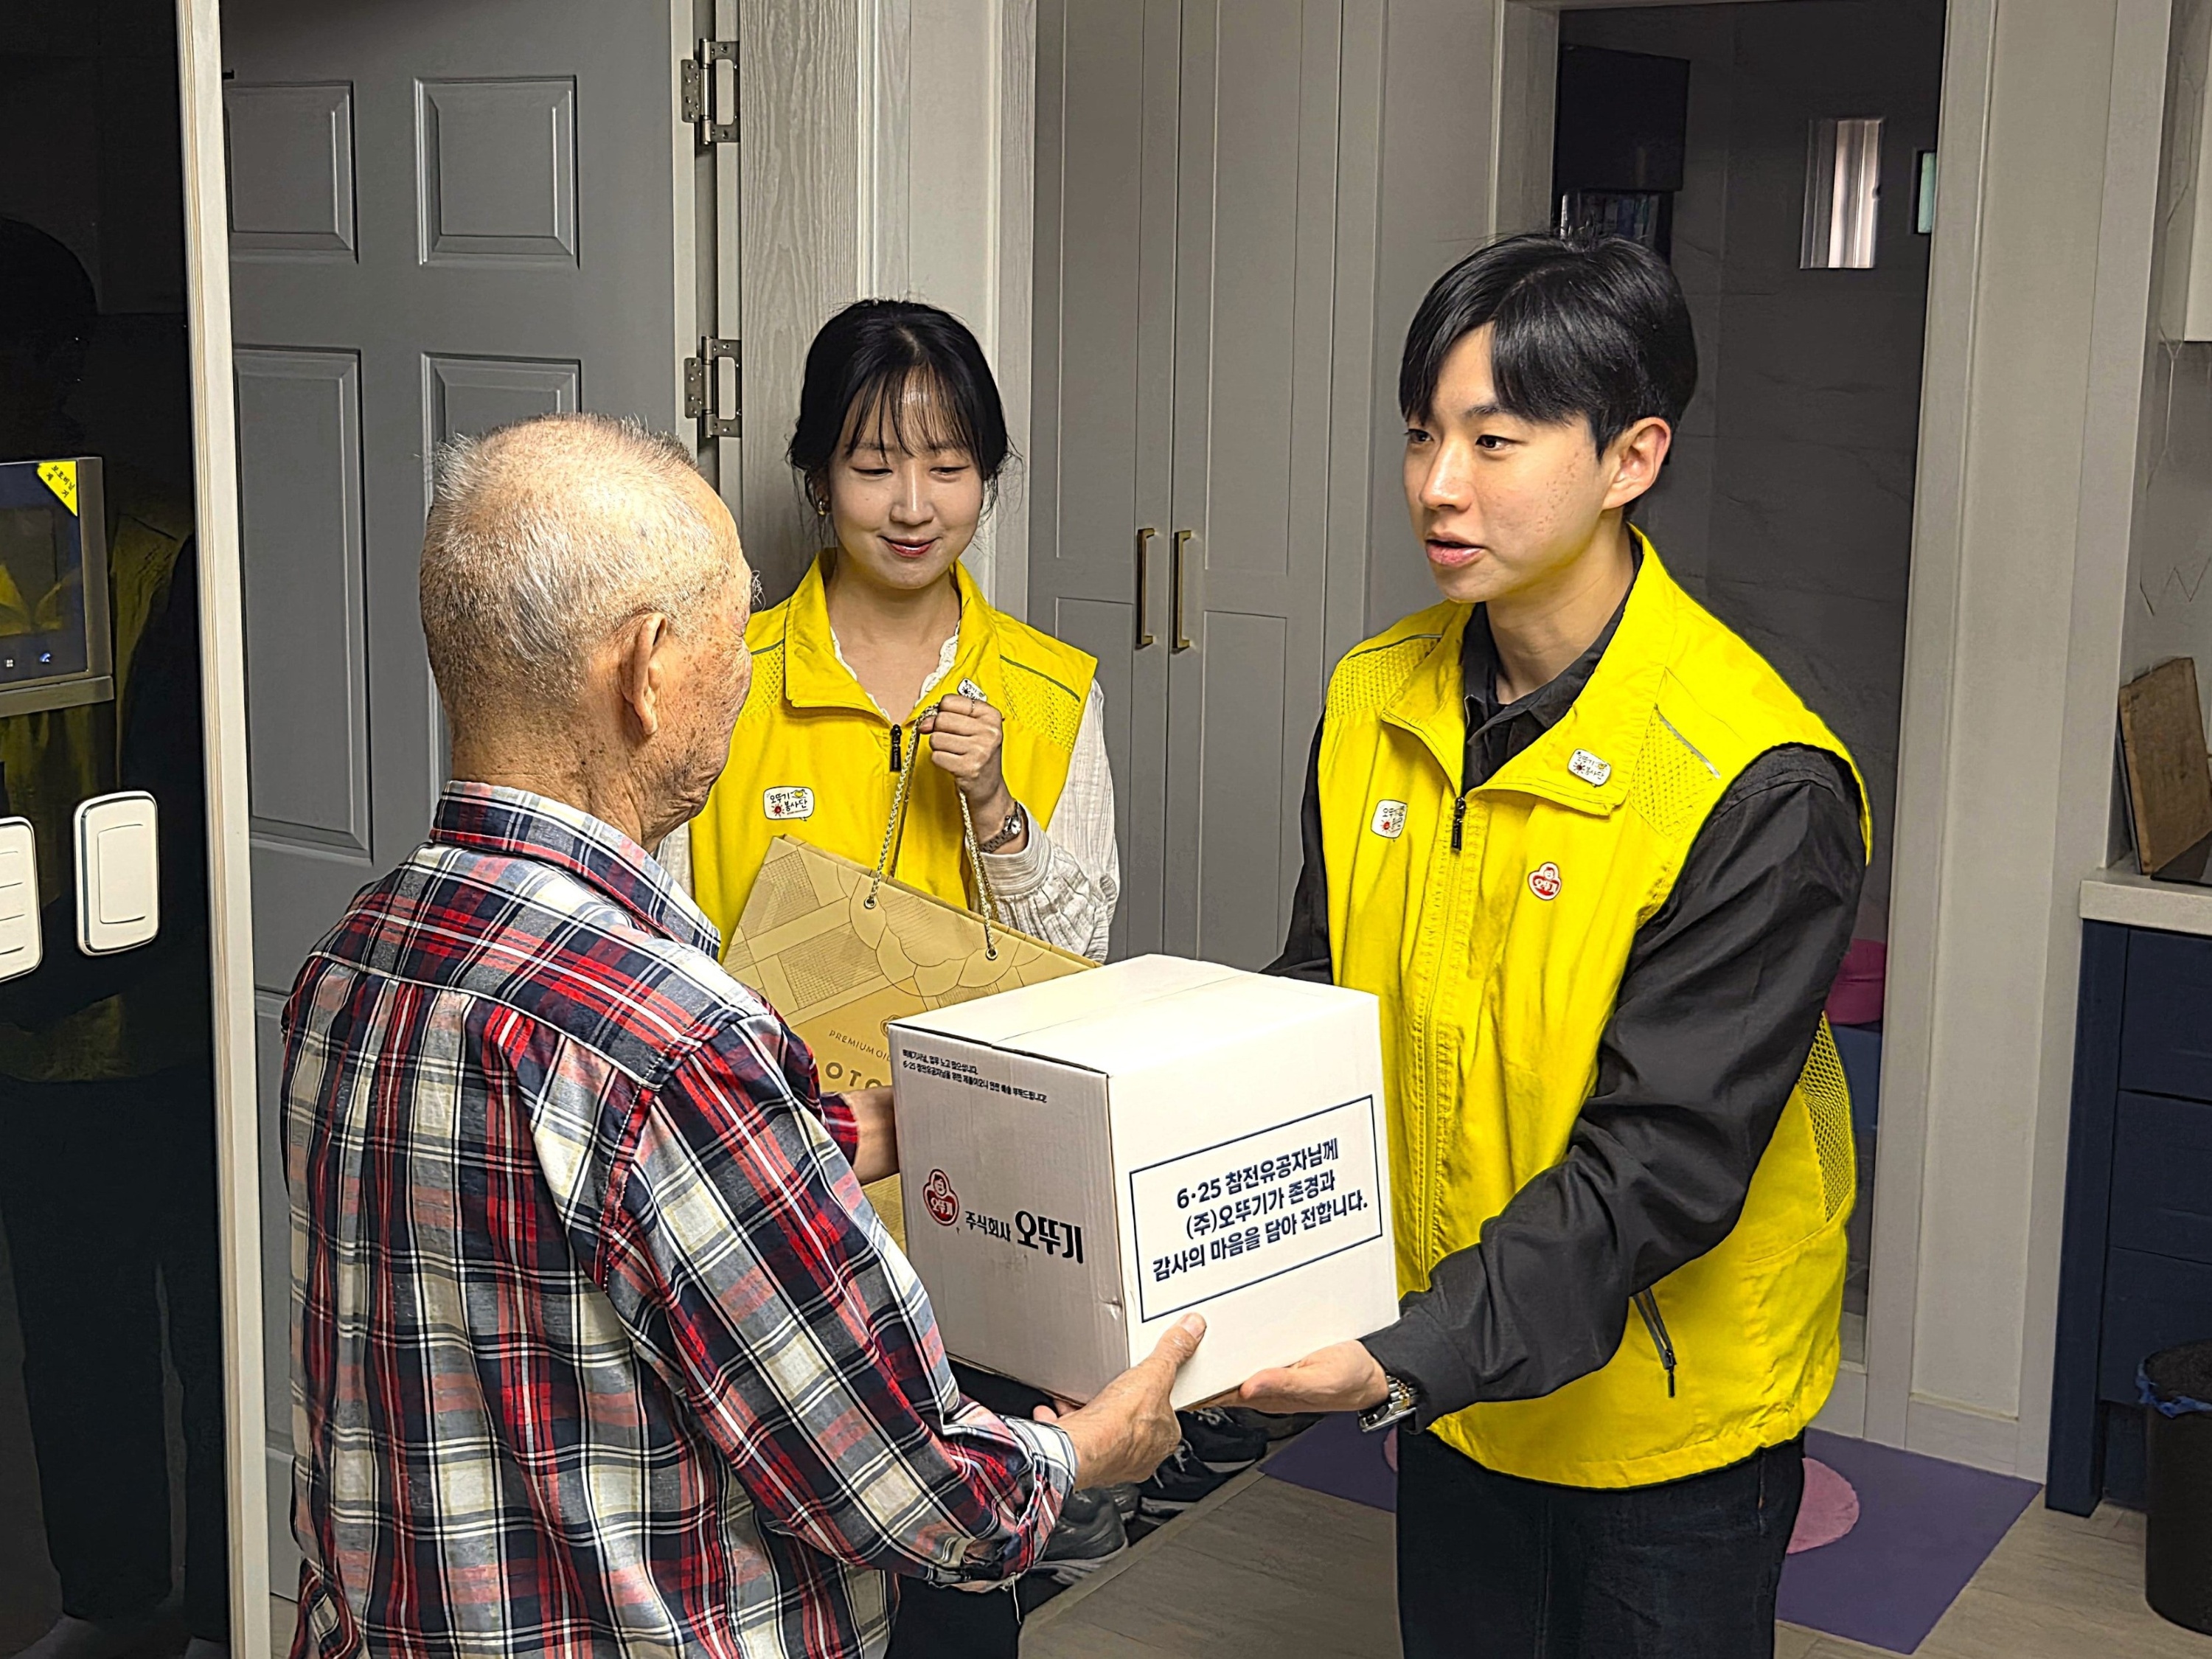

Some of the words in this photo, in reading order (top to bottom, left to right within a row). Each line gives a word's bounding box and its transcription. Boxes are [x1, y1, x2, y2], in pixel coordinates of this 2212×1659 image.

[769, 792, 790, 804] 오뚜기
[784, 799, 808, 812] 봉사단
[829, 1029, 874, 1055] PREMIUM
[1225, 1138, 1338, 1195] 참전유공자님께
[930, 1197, 953, 1217] 오뚜기
[1186, 1187, 1284, 1239] (주)오뚜기가
[1288, 1169, 1335, 1206] 존경과
[964, 1210, 1012, 1242] 주식회사
[1015, 1210, 1084, 1264] 오뚜기
[1152, 1244, 1206, 1281] 감사의
[1210, 1225, 1261, 1260] 마음을
[1265, 1213, 1297, 1244] 담아
[1301, 1189, 1368, 1231] 전합니다.
